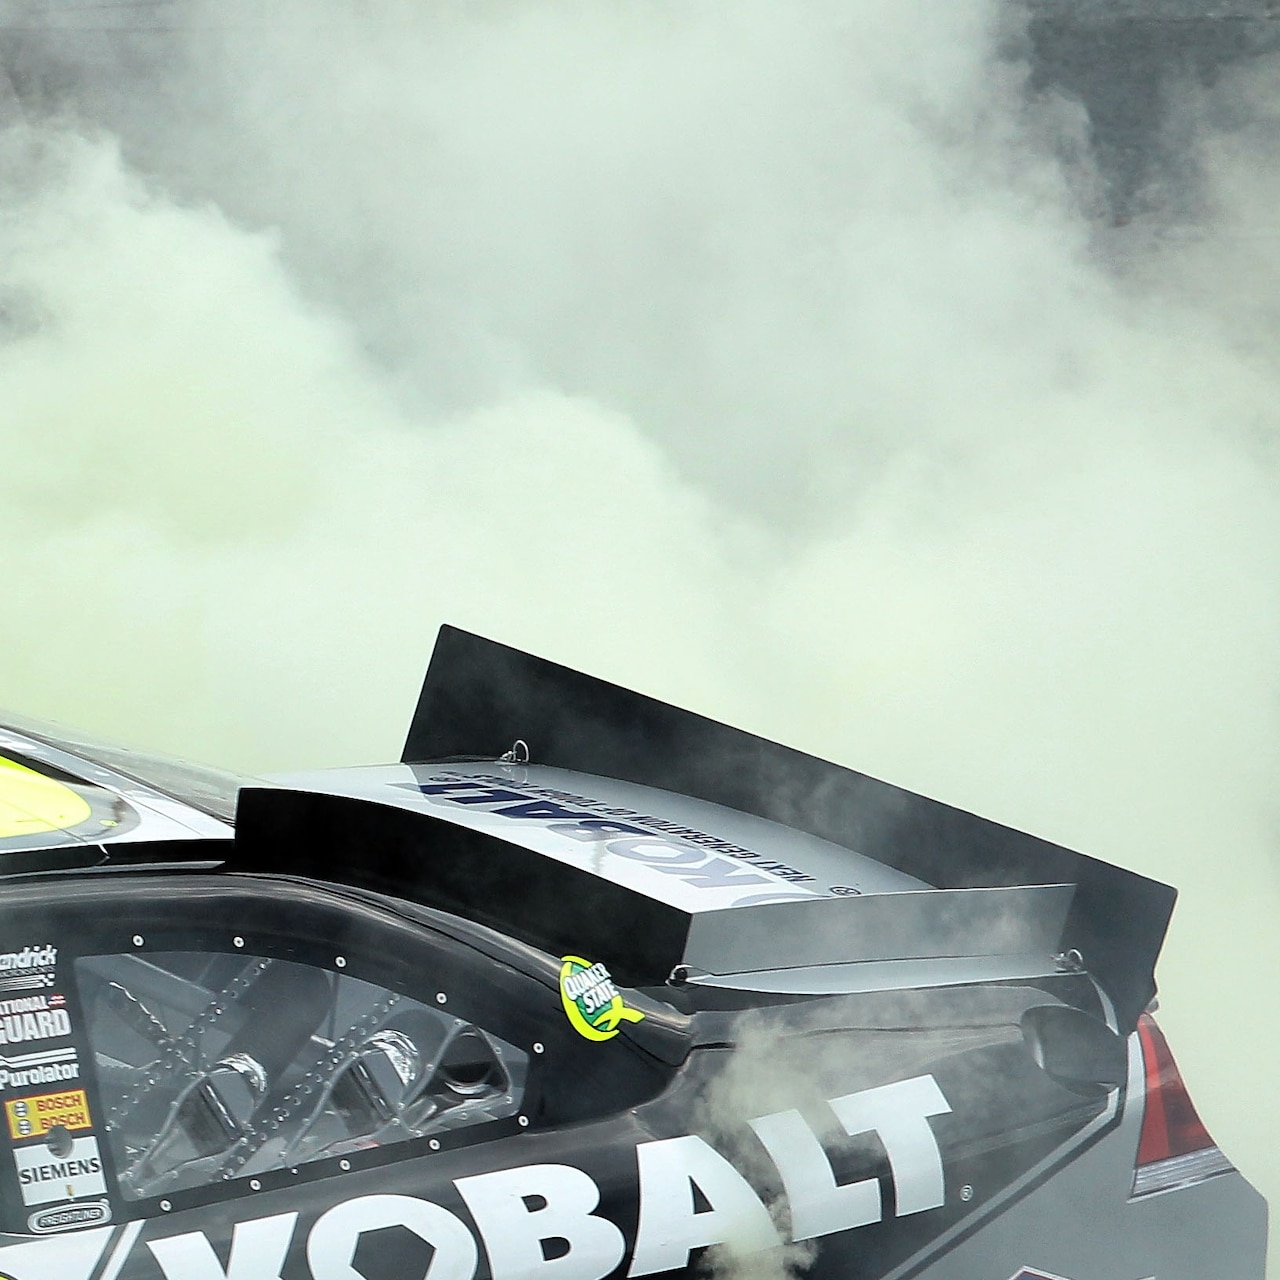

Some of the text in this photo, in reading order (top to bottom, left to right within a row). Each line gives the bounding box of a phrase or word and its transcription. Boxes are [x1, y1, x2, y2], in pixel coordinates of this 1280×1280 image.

[386, 782, 776, 889] KOBALT
[636, 815, 761, 862] GENERATION
[755, 859, 818, 884] NEXT
[564, 963, 612, 1000] QUAKER
[583, 979, 620, 1013] STATE
[37, 1094, 81, 1112] BOSCH
[41, 1112, 86, 1130] BOSCH
[18, 1157, 101, 1185] SIEMENS
